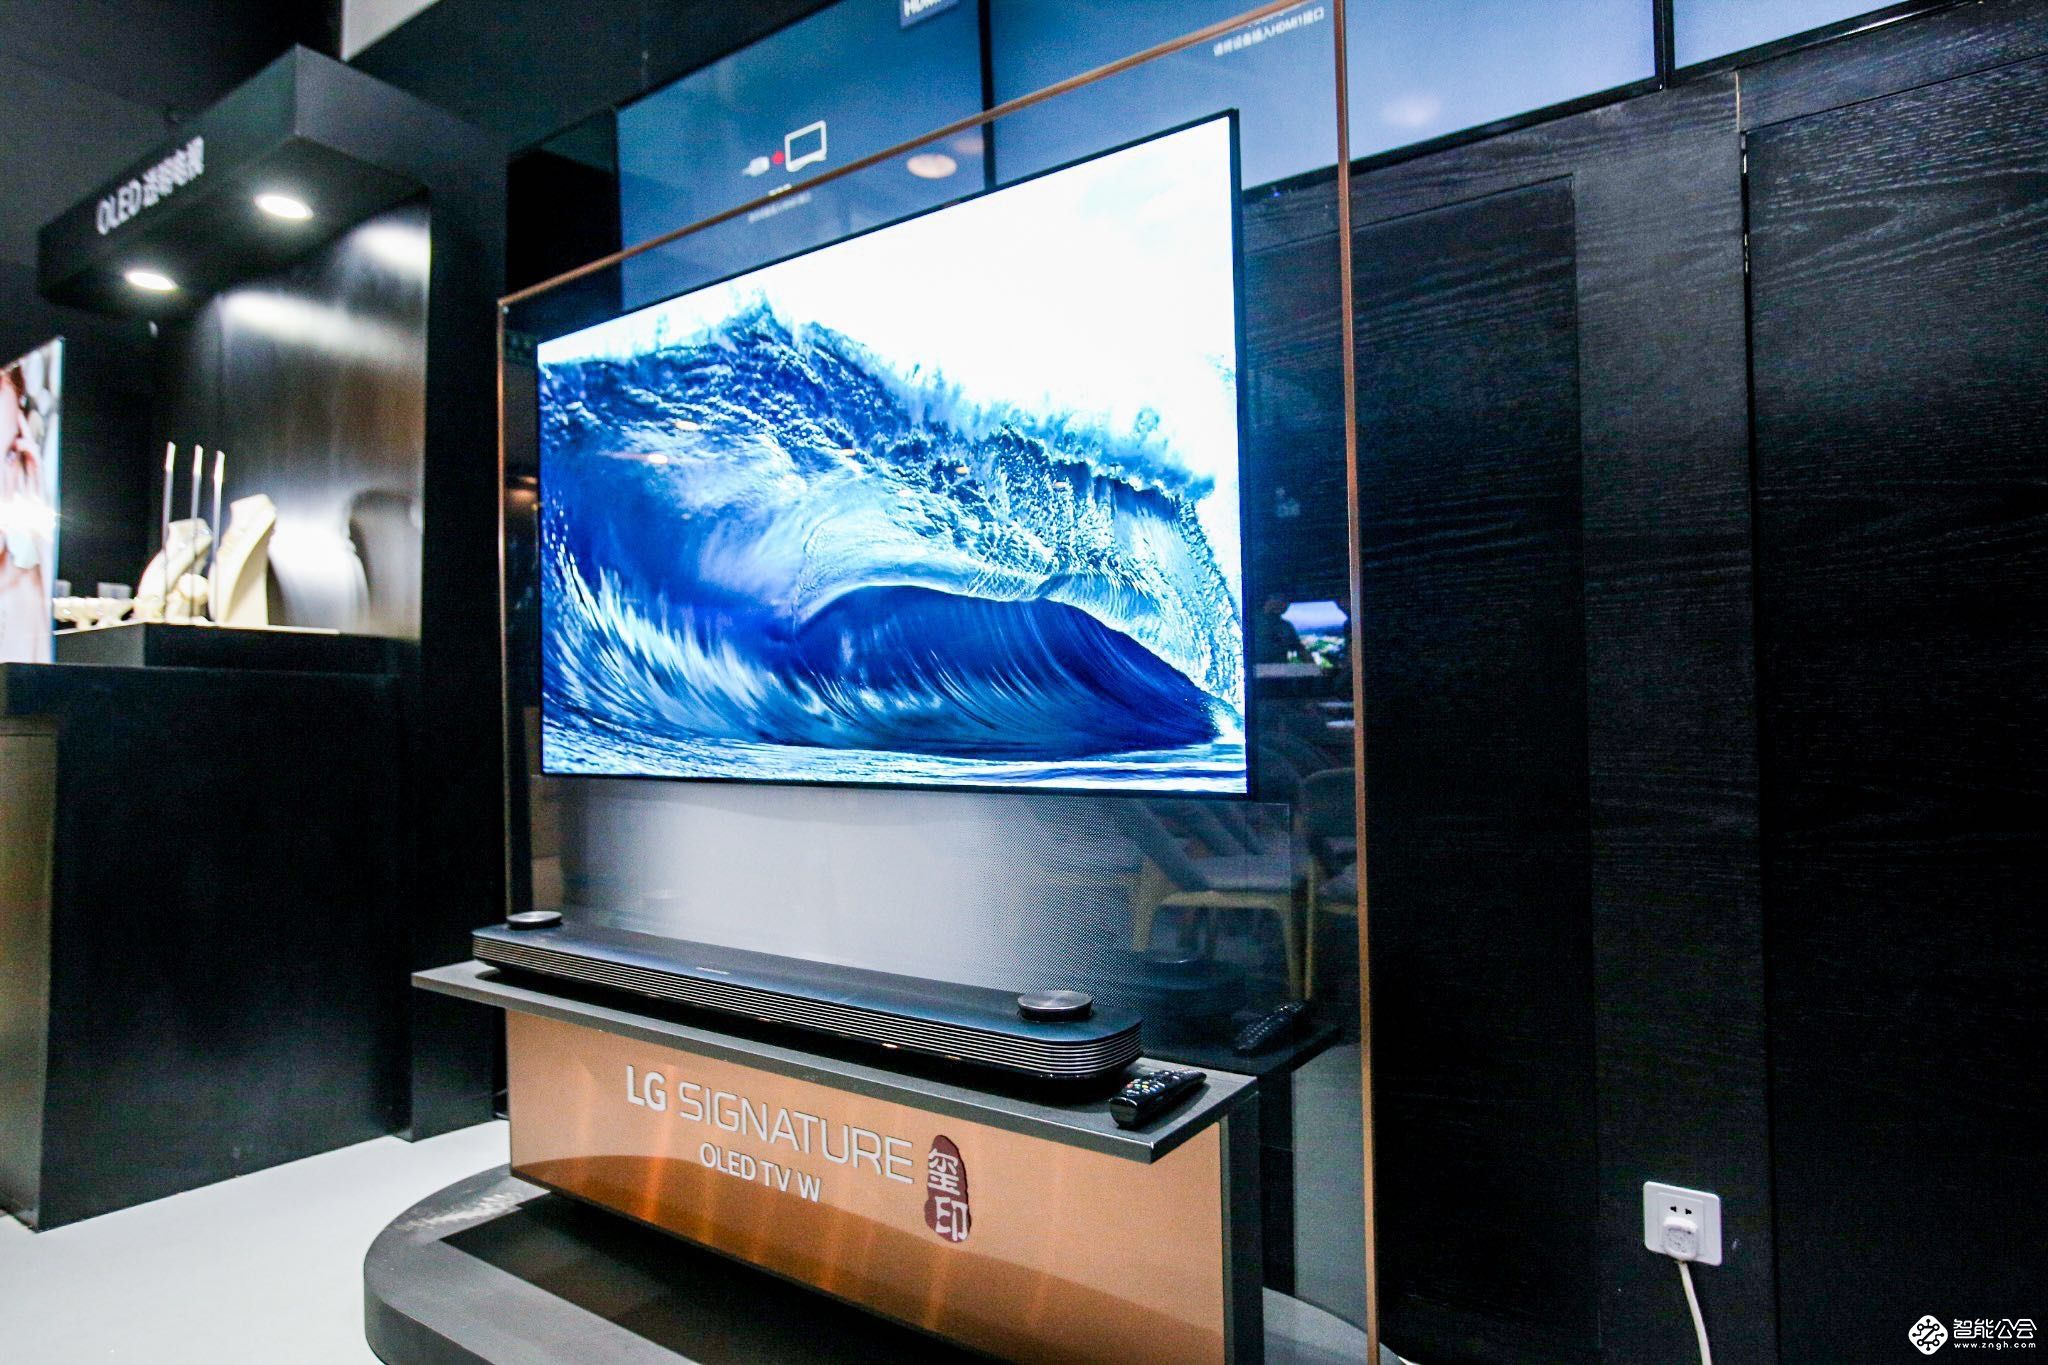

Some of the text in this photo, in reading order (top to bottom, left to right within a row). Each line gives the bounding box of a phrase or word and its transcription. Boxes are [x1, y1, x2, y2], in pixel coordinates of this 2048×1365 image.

[96, 178, 141, 236] OLED
[625, 1064, 915, 1185] LG SIGNATURE
[699, 1141, 822, 1203] OLED TV W
